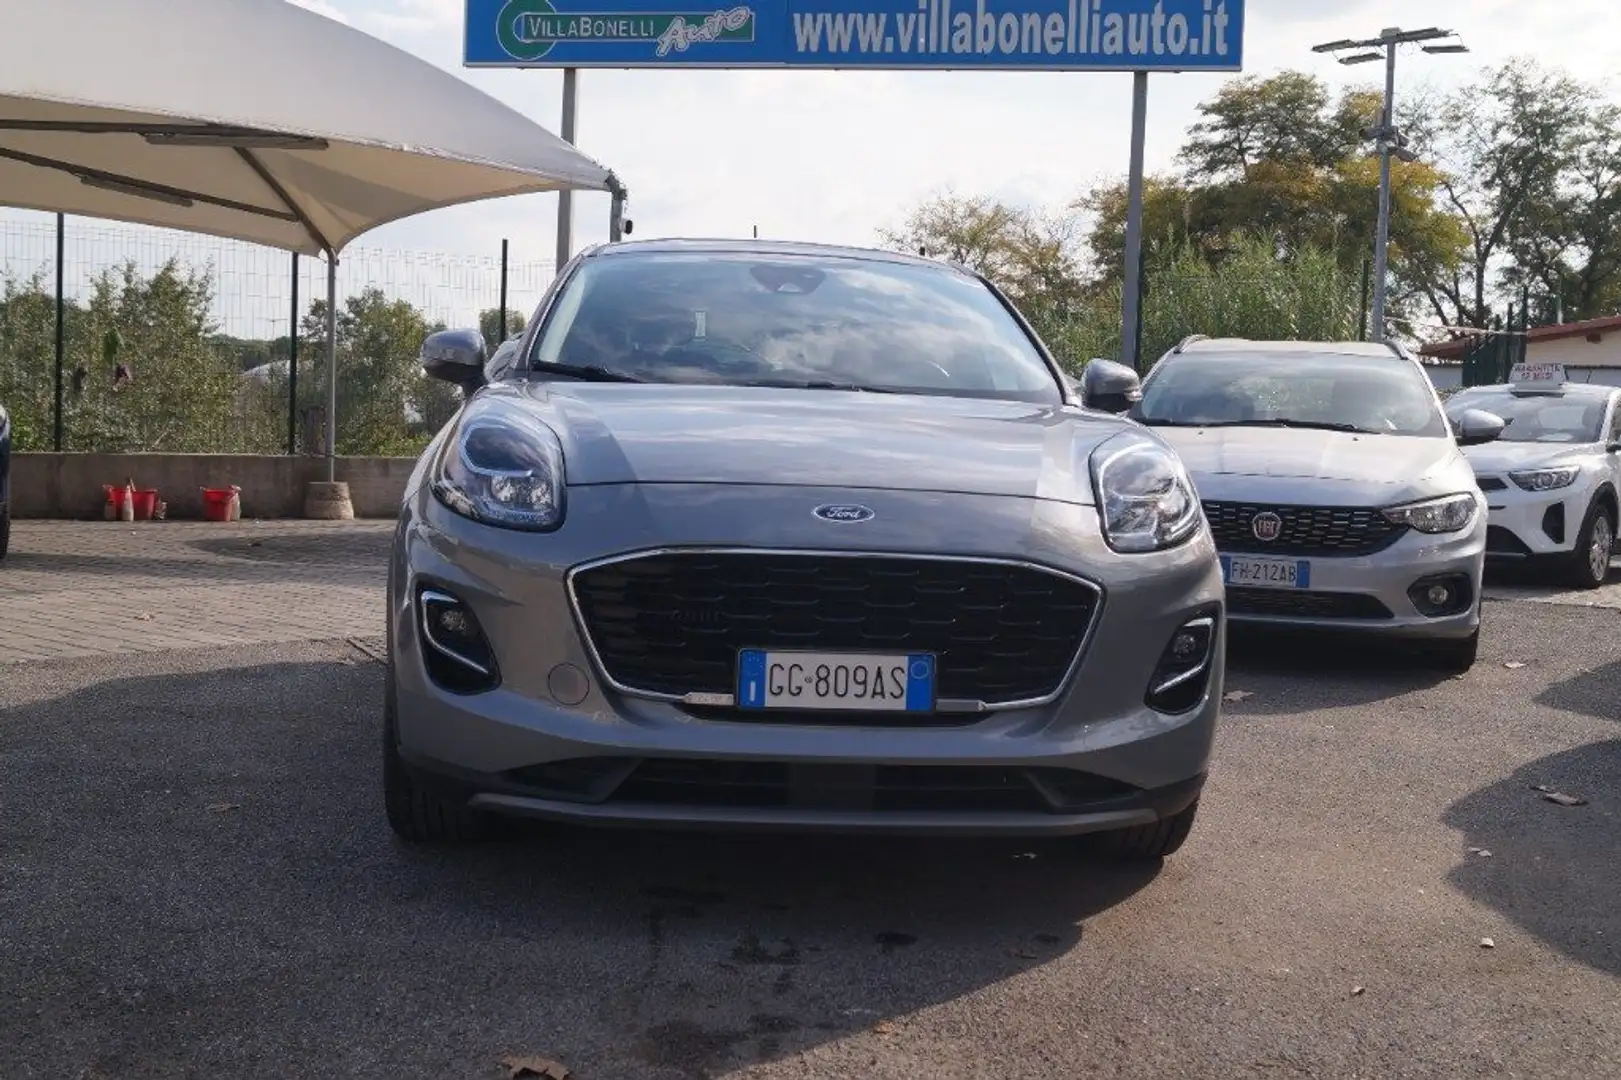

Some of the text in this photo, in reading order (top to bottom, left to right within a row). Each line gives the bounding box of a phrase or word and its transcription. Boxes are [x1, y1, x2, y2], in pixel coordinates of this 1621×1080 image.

[656, 7, 751, 57] Auto
[793, 0, 1229, 54] www.villabonelliauto.it
[826, 506, 861, 519] Ford
